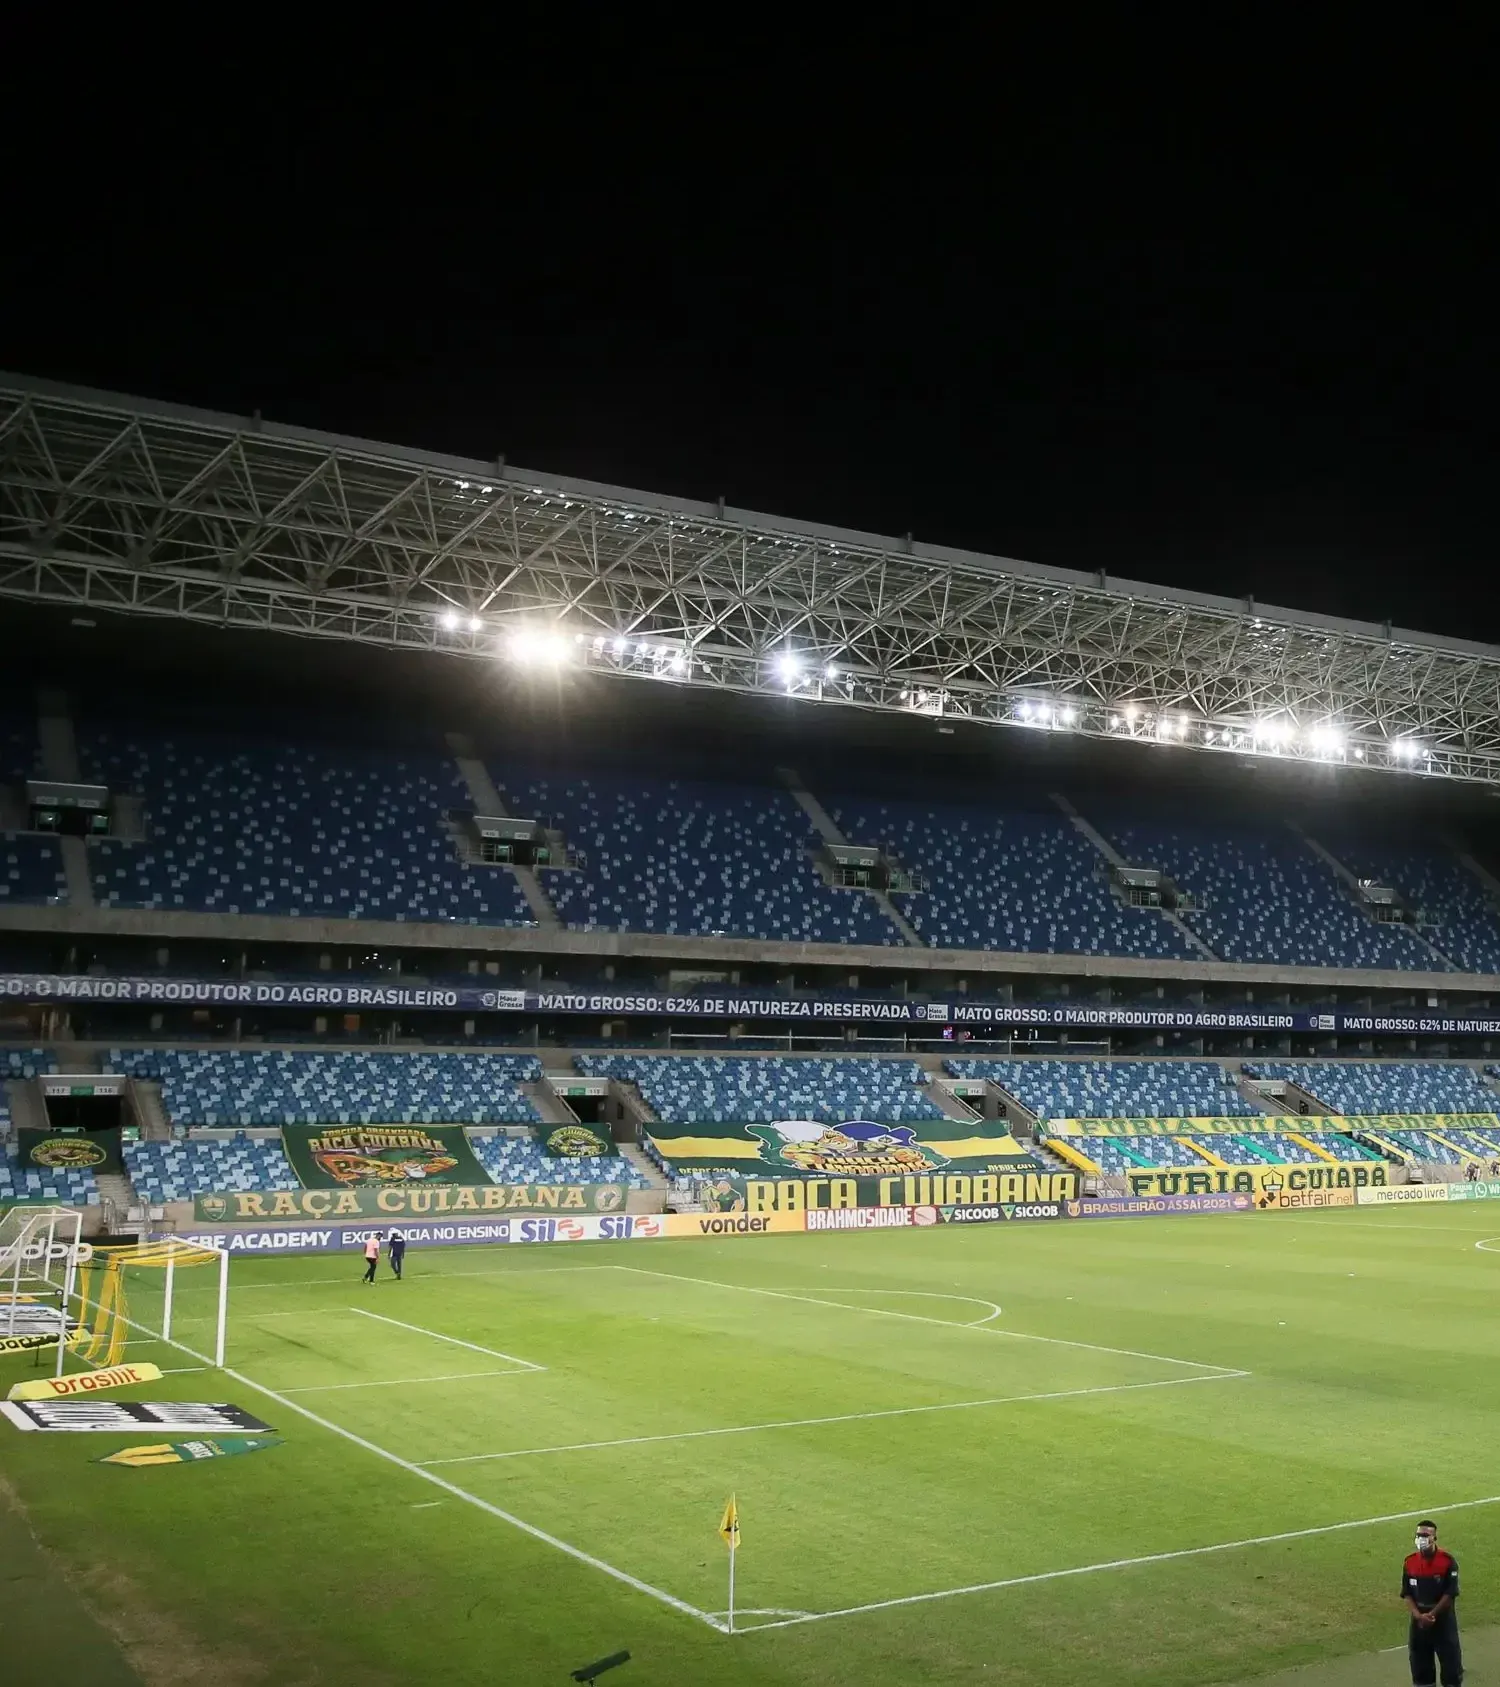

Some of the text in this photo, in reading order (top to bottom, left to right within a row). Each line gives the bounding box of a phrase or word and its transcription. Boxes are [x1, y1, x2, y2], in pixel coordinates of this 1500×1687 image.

[57, 980, 131, 998] MAIOR
[136, 982, 247, 1001] PRODUTOR
[249, 986, 285, 1002] DO
[288, 987, 343, 1004] AGRO
[347, 988, 457, 1006] BRASILEIRO
[538, 995, 910, 1018] MATO GROSSO: 62% DE NATUREZA PRESERVADA
[953, 1007, 1293, 1028] MATO GROSSO: O MAIOR PRODUTOR DO AGRO BRASILEIRO
[1343, 1016, 1373, 1029] MATO
[1374, 1018, 1418, 1030] GROSSO:
[1420, 1019, 1441, 1031] 62%
[1442, 1020, 1455, 1031] DE
[1345, 1116, 1437, 1130] DESDE
[879, 1173, 1075, 1208] CUIABANA
[1377, 1186, 1445, 1201] mercado livre
[1450, 1184, 1473, 1193] Pague
[234, 1186, 587, 1219] RAÇA CUIABANA
[1015, 1204, 1058, 1218] SICOOB
[1083, 1199, 1165, 1214] BRASILEIRÃO
[1203, 1200, 1231, 1210] 2021
[699, 1213, 770, 1234] vonder
[807, 1207, 913, 1230] BRAHMOSIDADE
[954, 1207, 999, 1221] SICOOB
[433, 1227, 454, 1239] NO
[458, 1225, 509, 1239] ENSINO
[520, 1219, 556, 1242] Sil
[599, 1216, 633, 1239] Sil
[229, 1230, 333, 1249] ACADEMY
[48, 1366, 142, 1396] brasilit
